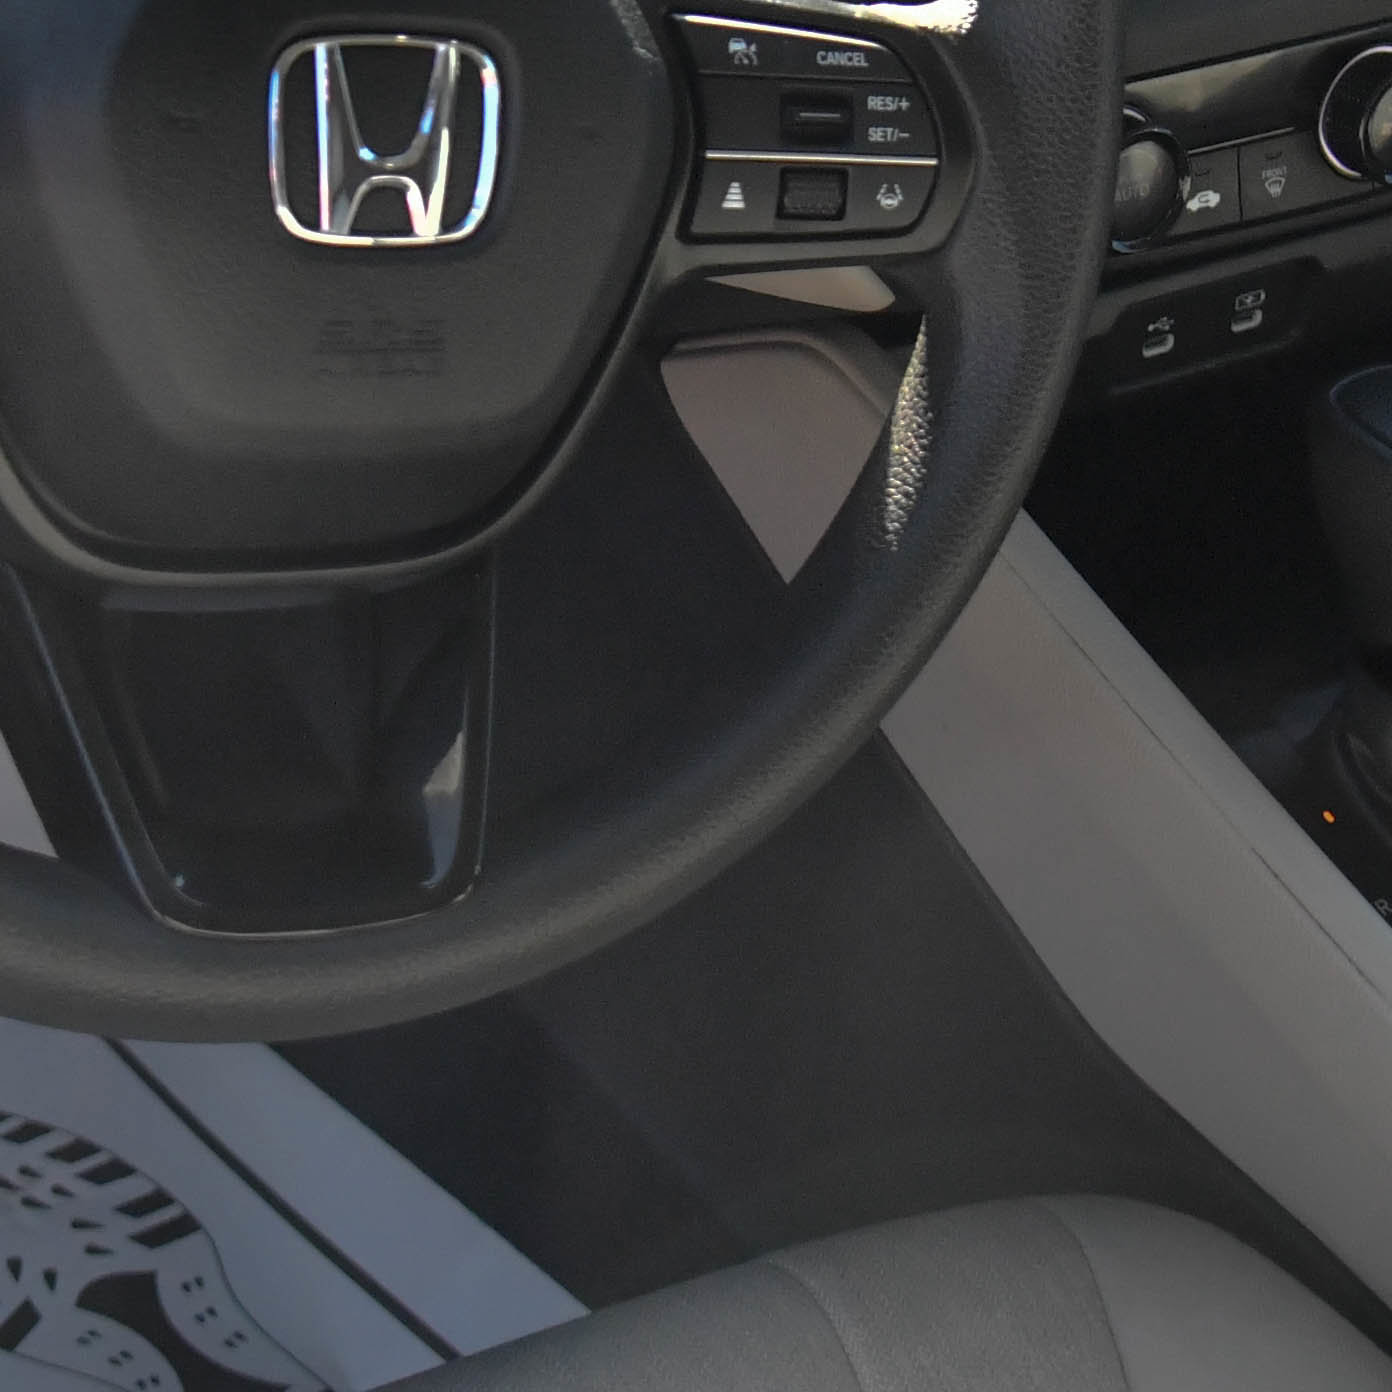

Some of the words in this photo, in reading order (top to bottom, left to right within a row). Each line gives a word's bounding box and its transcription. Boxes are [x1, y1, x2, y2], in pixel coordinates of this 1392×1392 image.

[816, 50, 870, 67] CANCEL
[867, 95, 911, 112] RES/+
[1261, 165, 1289, 181] FRONT
